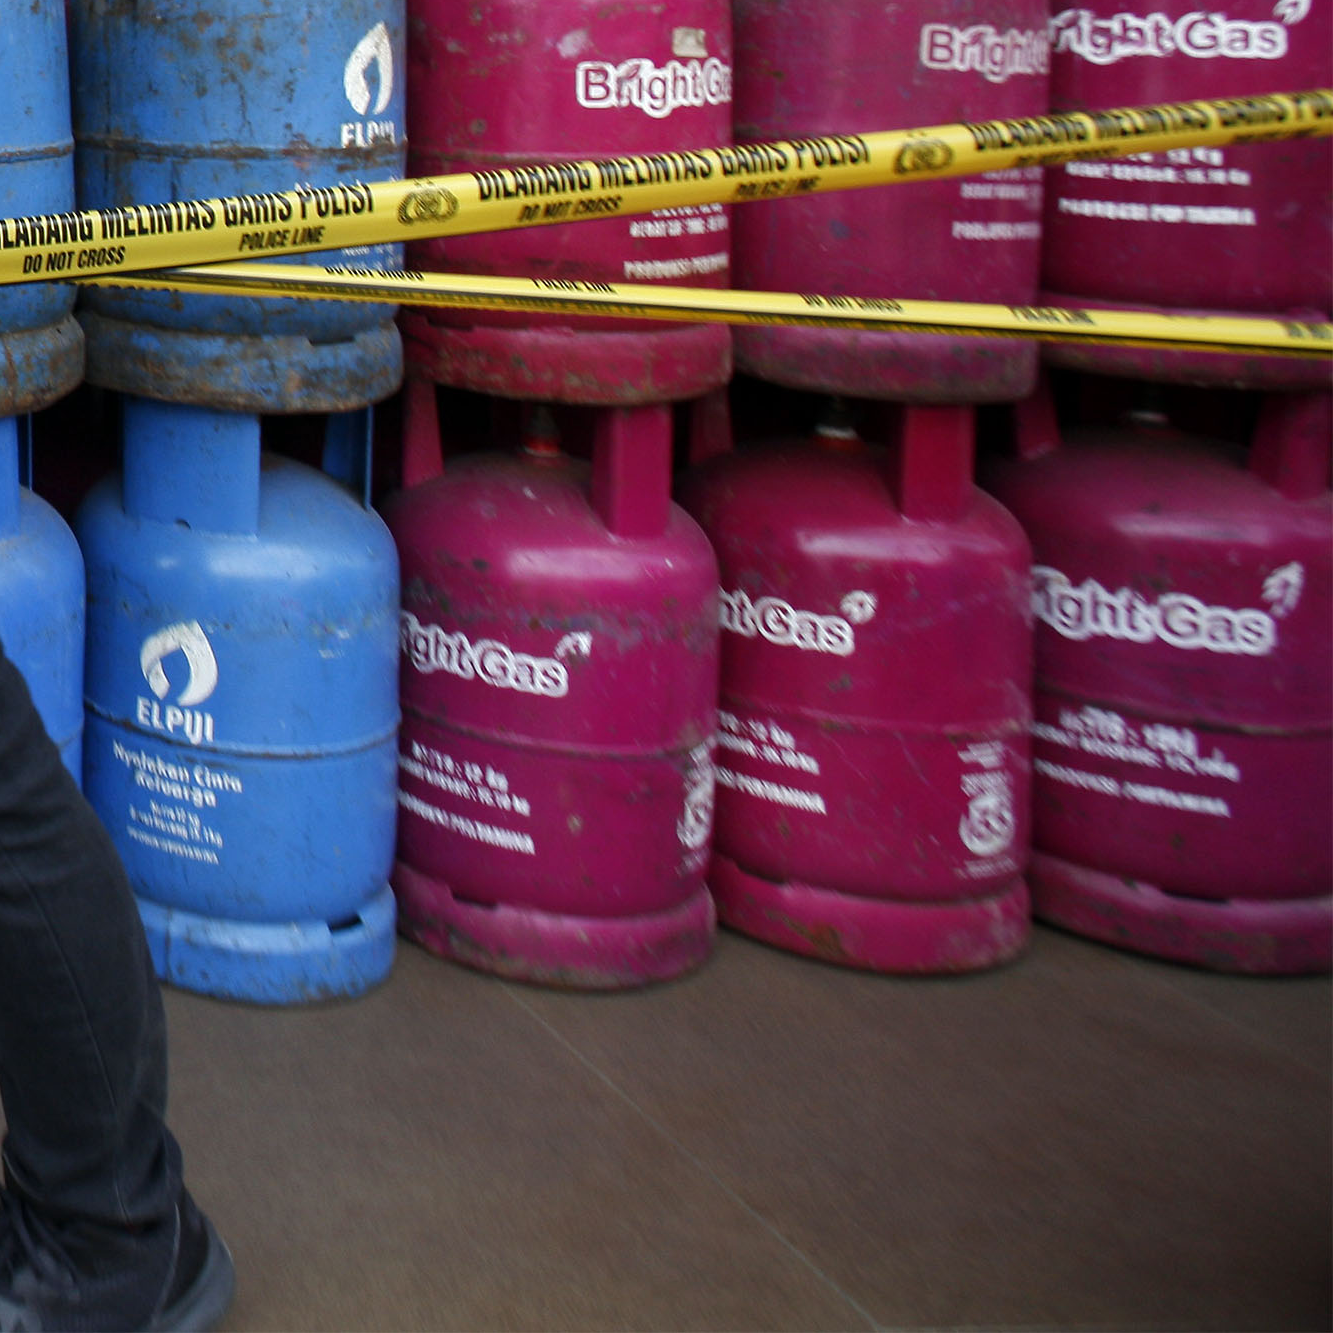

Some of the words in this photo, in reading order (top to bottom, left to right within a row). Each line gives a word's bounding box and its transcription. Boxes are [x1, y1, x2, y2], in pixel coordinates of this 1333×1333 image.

[100, 199, 216, 240] MELINTAS
[238, 229, 290, 253] POLICE
[292, 225, 326, 246] LINE
[22, 253, 42, 275] DO
[46, 250, 73, 273] NOT
[77, 246, 126, 270] CROSS
[112, 738, 191, 784] Nyalakan
[192, 764, 243, 794] Cinta
[135, 768, 217, 809] Keluarga
